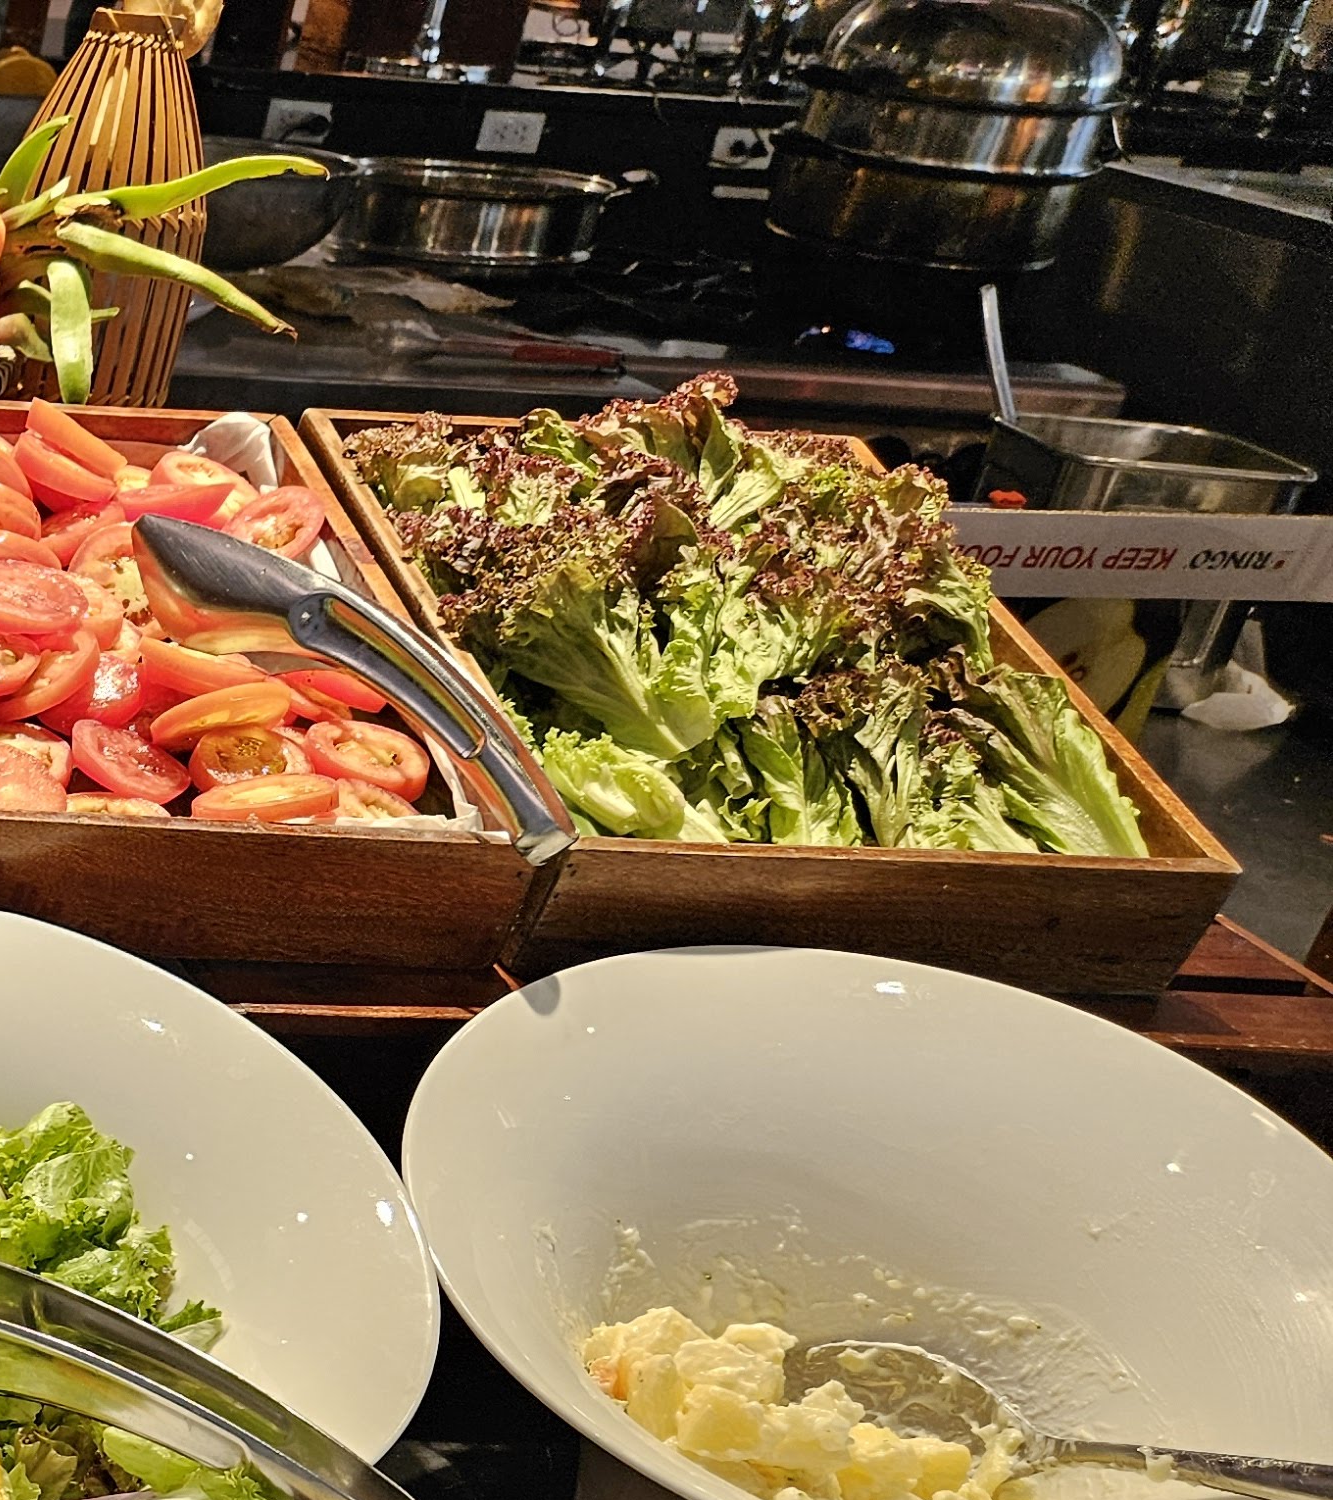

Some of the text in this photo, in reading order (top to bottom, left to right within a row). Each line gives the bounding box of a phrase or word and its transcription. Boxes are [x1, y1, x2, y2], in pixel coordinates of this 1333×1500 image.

[952, 544, 1020, 569] FOO
[1023, 545, 1097, 569] YOUR
[1102, 547, 1177, 571] KEEP
